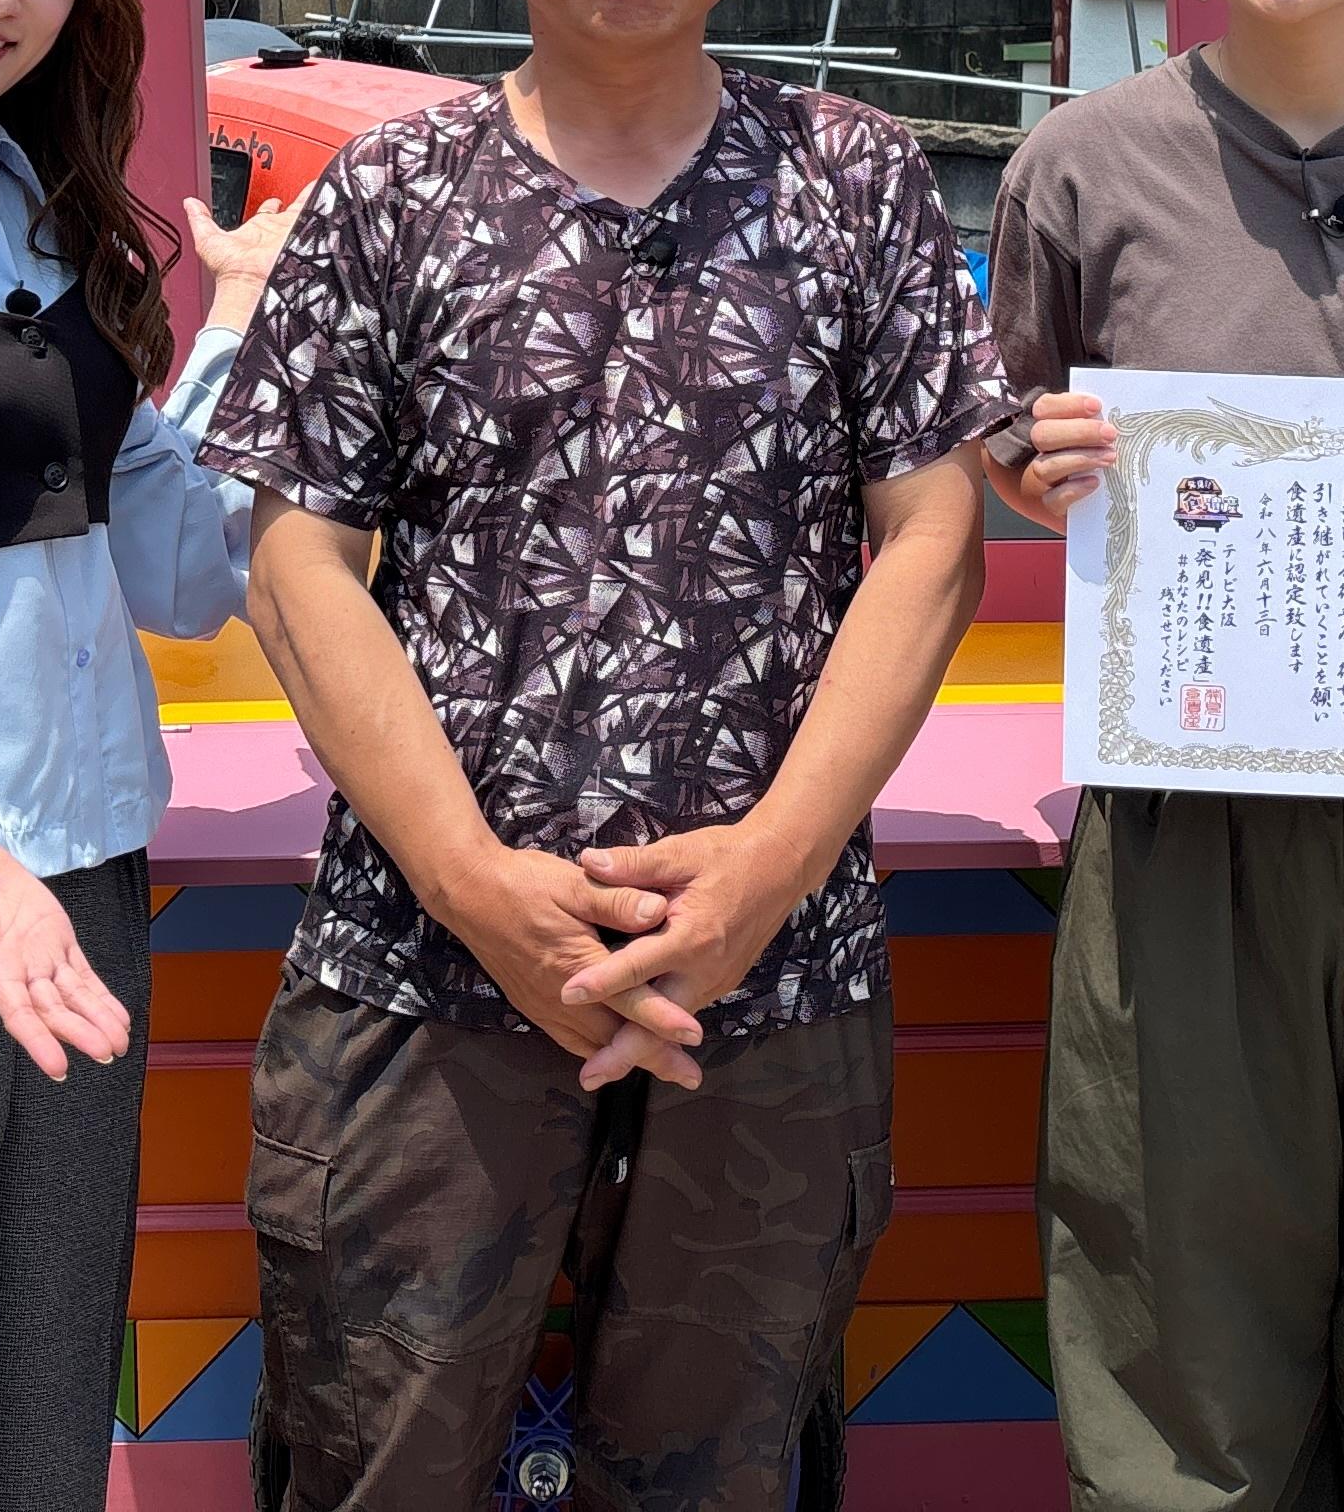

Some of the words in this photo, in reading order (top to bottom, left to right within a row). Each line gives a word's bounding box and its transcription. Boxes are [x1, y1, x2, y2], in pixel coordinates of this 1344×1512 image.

[1221, 544, 1237, 627] テレビ大阪
[1255, 494, 1277, 636] 令和八年六月十三日
[1285, 481, 1307, 673] 食遺産に認定致します
[1310, 483, 1333, 722] 引き継がれていくことを願い
[1159, 587, 1175, 706] 残させてください
